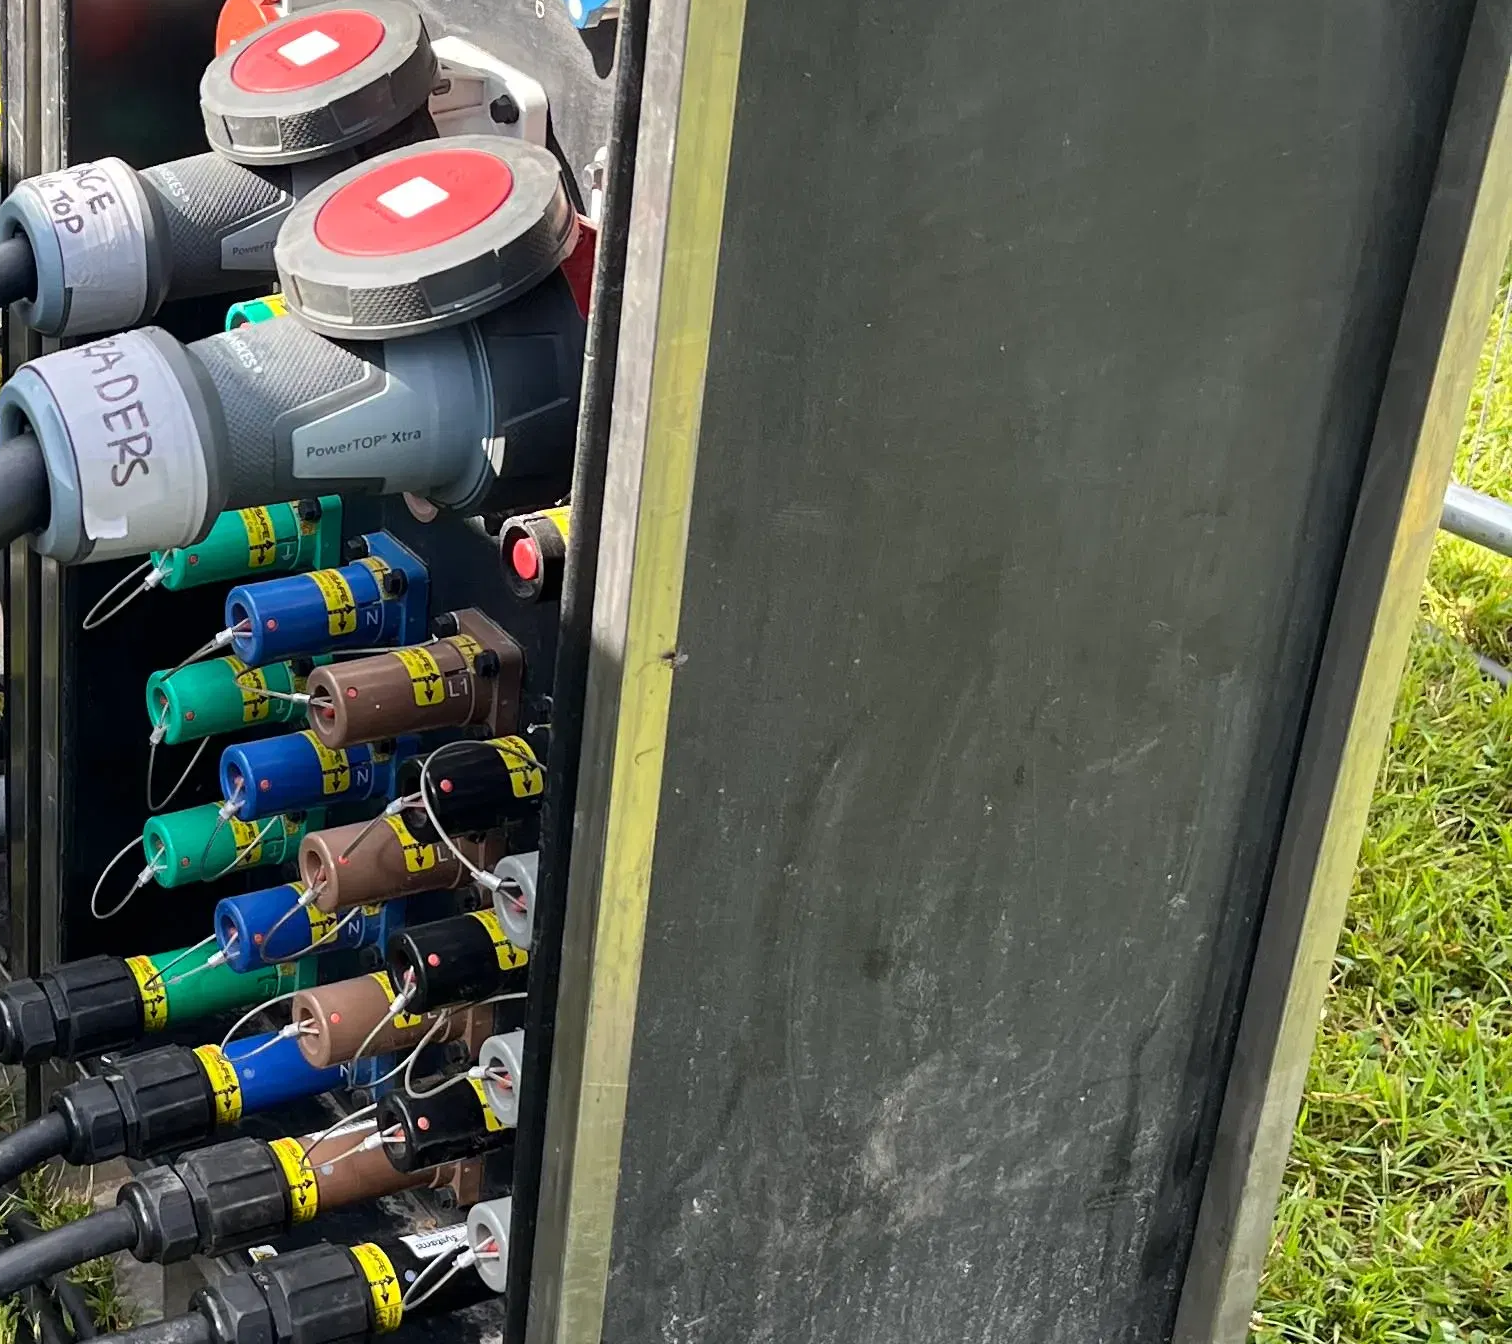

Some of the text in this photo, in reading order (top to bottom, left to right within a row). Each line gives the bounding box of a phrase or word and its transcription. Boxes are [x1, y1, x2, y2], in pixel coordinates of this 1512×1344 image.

[75, 337, 153, 487] RADERS
[391, 429, 422, 444] Xtra
[366, 609, 379, 625] N
[446, 676, 469, 697] L1
[357, 769, 369, 786] N
[348, 919, 360, 935] N
